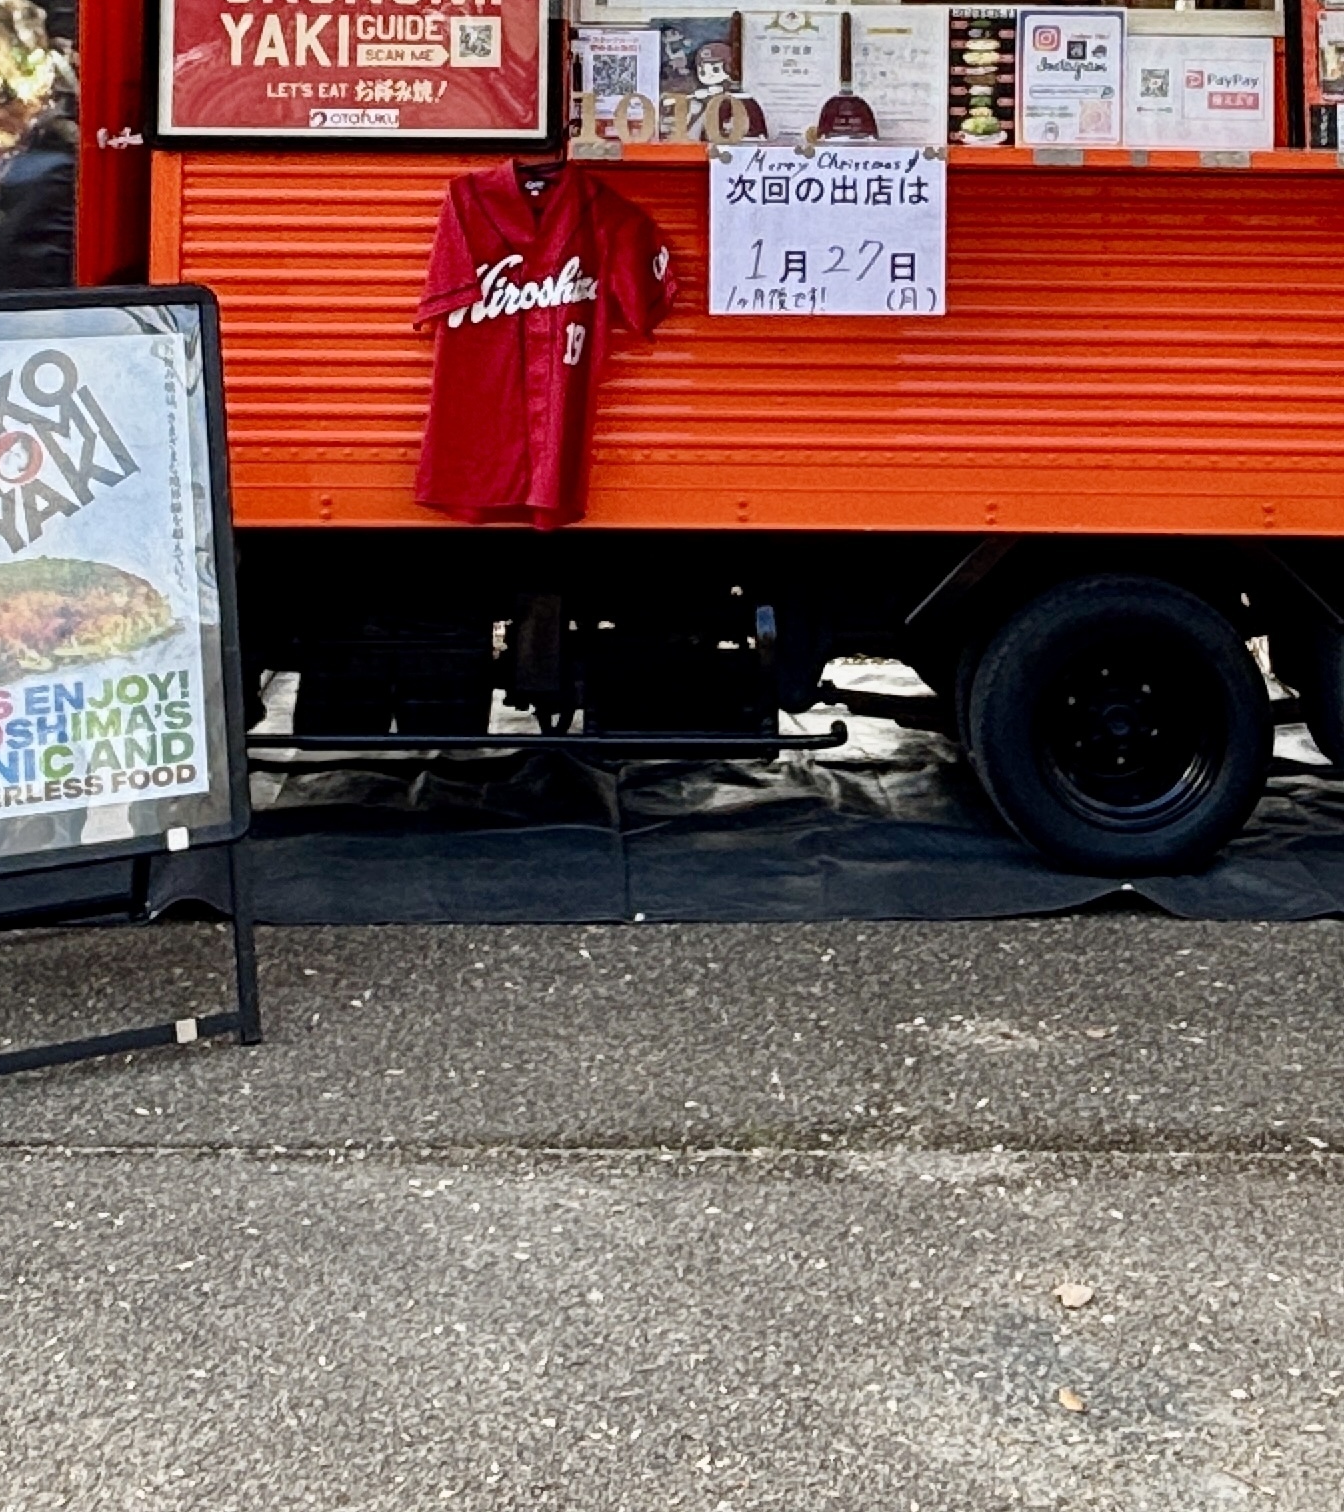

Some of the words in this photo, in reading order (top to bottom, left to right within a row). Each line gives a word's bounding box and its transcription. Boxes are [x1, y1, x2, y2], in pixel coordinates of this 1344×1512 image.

[220, 13, 350, 67] YAKI
[357, 15, 444, 41] GUIDE
[365, 49, 406, 62] SCAN
[411, 49, 435, 62] ME
[1037, 57, 1108, 81] Instagram
[266, 83, 313, 98] LET'S
[318, 83, 348, 98] EAT
[1207, 73, 1259, 89] PayPay
[746, 148, 809, 180] Merry
[726, 174, 929, 206] 次回の出店は
[89, 732, 194, 775] AND
[111, 764, 197, 794] FOOD
